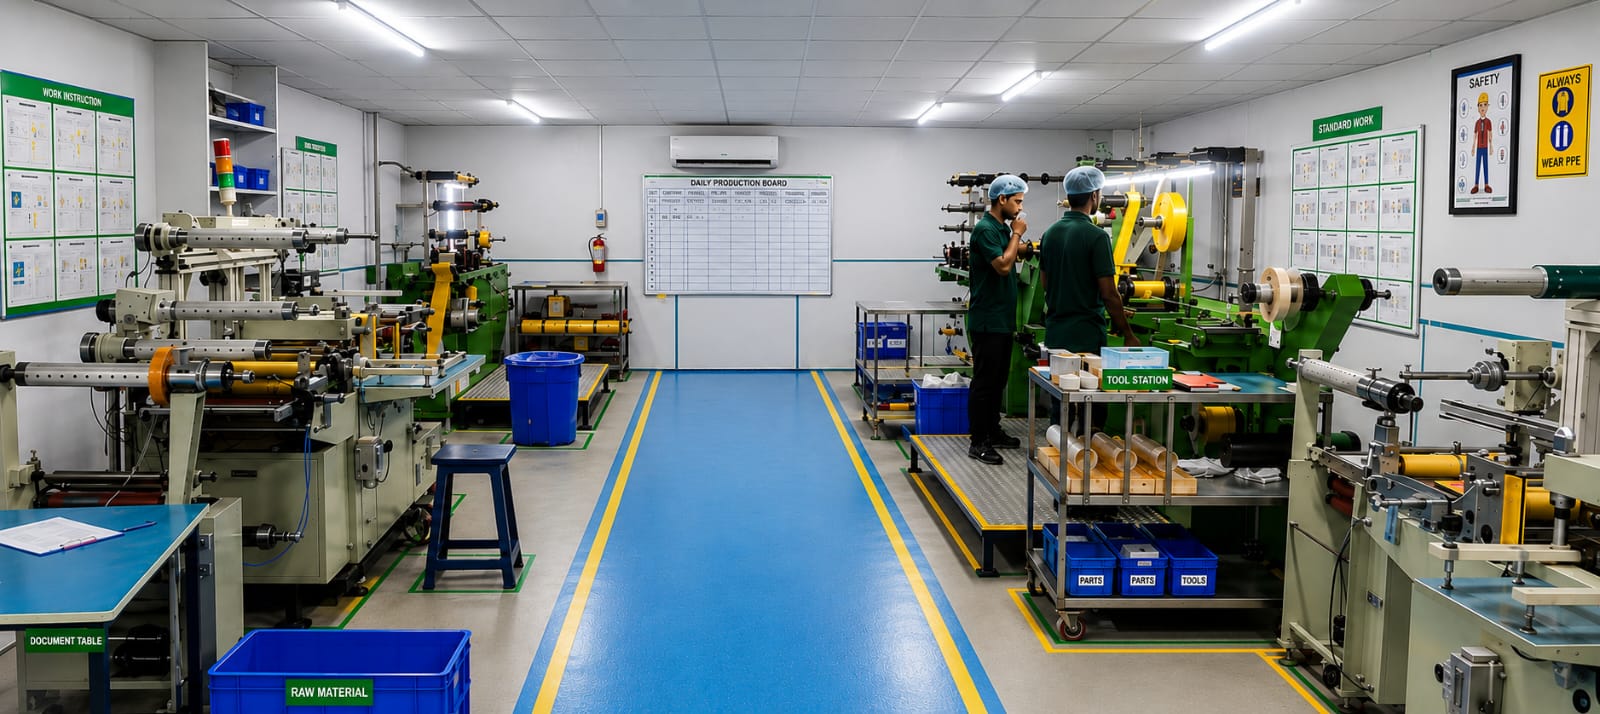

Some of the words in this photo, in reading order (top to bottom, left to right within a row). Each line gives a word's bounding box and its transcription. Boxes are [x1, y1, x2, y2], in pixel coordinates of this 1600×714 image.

[1469, 73, 1500, 89] SAFETY
[1546, 73, 1581, 89] ALWAYS
[43, 88, 62, 99] WORK
[64, 91, 102, 107] INSTRUCTION
[1318, 120, 1352, 134] STANDARD
[1353, 115, 1374, 128] WORK
[1542, 157, 1564, 168] WEAR
[1566, 156, 1581, 167] PPE
[1107, 375, 1130, 384] TOOL
[1132, 375, 1168, 384] STATION
[1080, 576, 1103, 584] PARTS
[1131, 576, 1154, 584] PARTS
[1182, 576, 1206, 584] TOOLS
[30, 636, 75, 646] DOCUMENT
[76, 636, 102, 646] TABLE
[291, 688, 315, 698] RAW
[317, 688, 368, 698] MATERIAL
